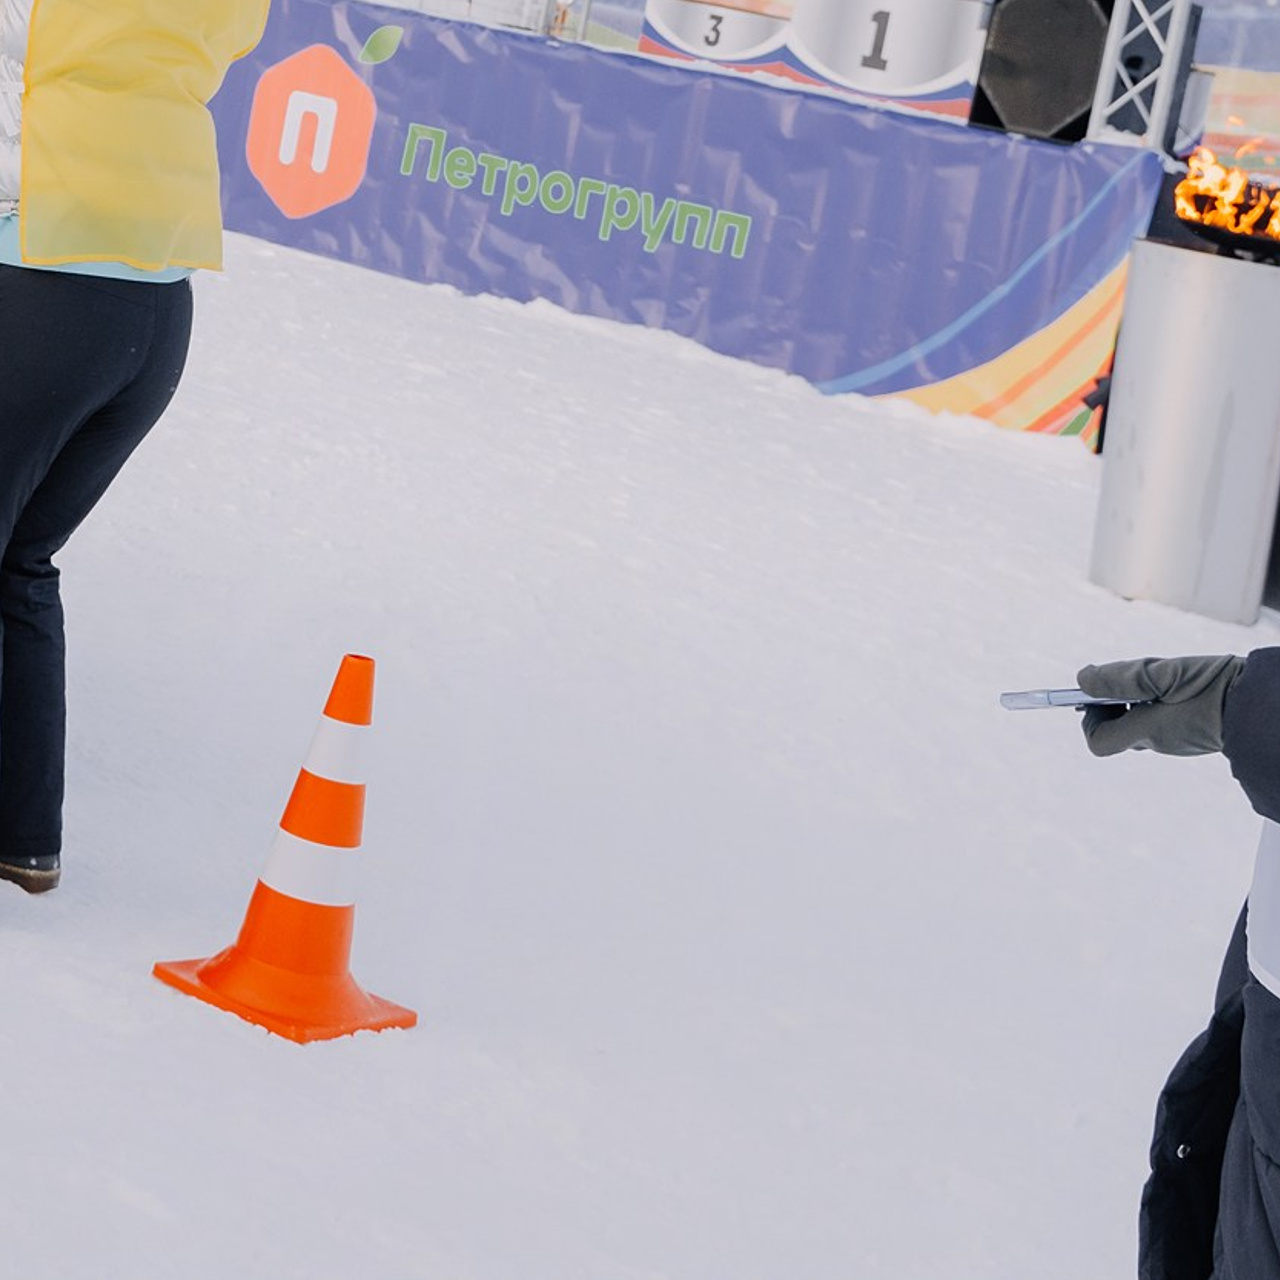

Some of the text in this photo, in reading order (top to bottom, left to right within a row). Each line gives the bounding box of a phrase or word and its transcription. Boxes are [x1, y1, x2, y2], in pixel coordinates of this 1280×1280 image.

[704, 14, 723, 47] 3
[860, 10, 891, 72] 1
[278, 89, 338, 174] П
[400, 122, 752, 259] Петрогрупп
